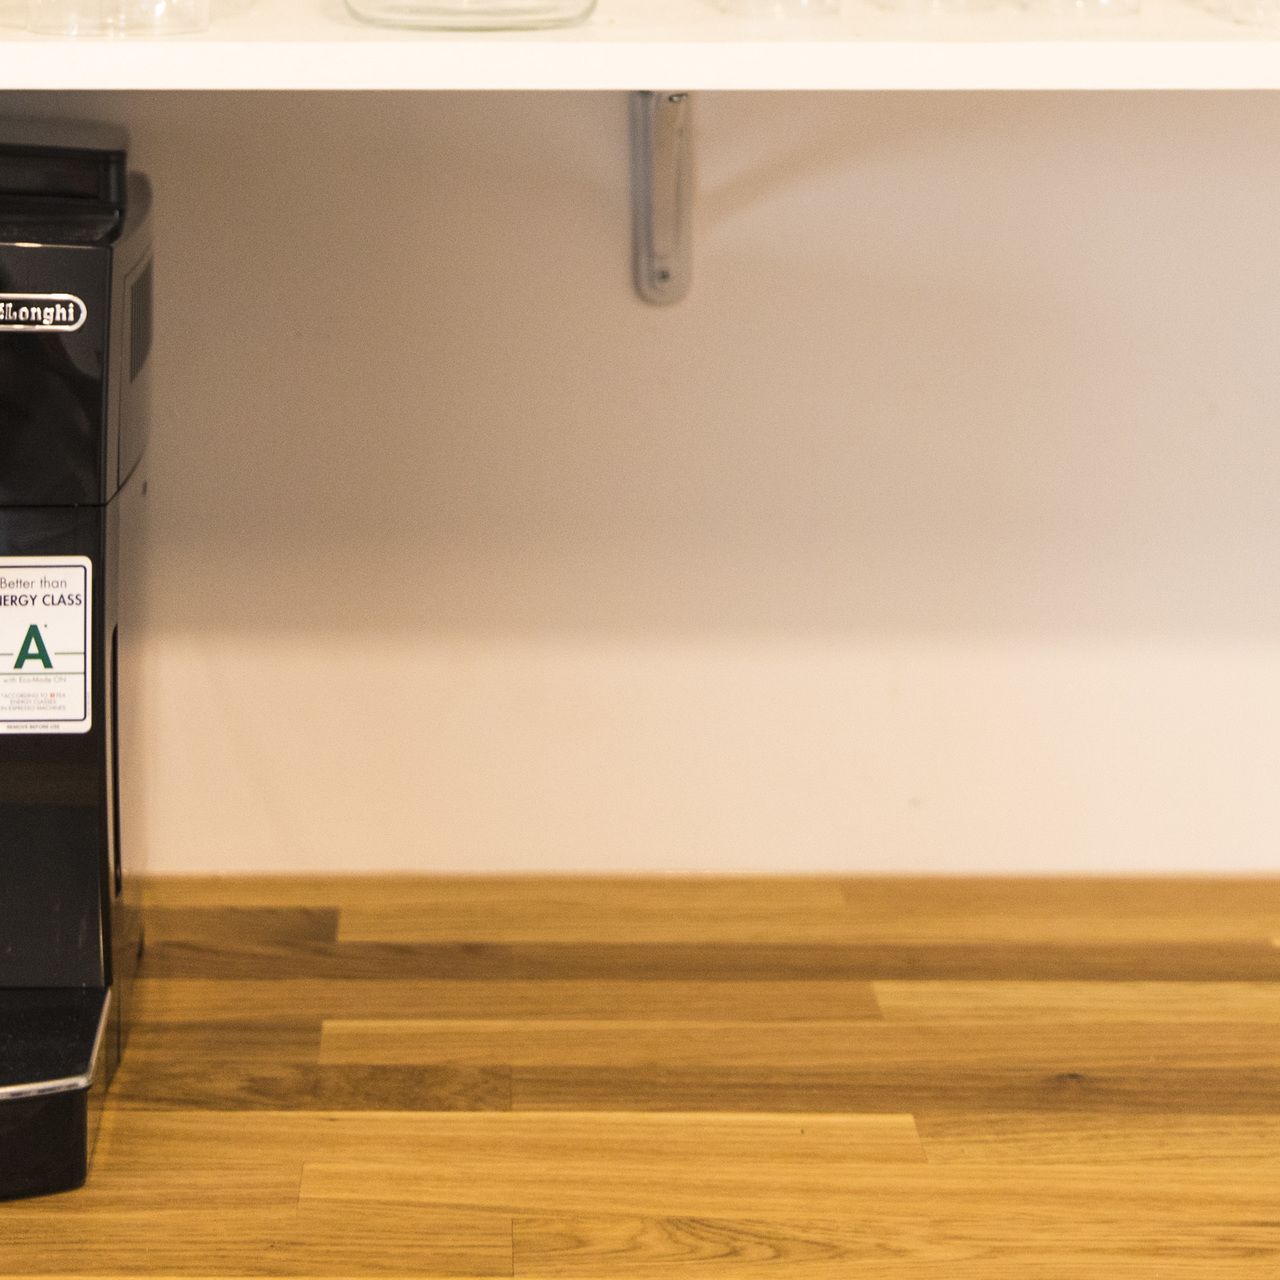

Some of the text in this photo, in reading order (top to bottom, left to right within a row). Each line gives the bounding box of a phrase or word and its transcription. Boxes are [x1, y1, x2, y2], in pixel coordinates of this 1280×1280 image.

[0, 575, 68, 589] Better than
[42, 593, 83, 606] CLASS
